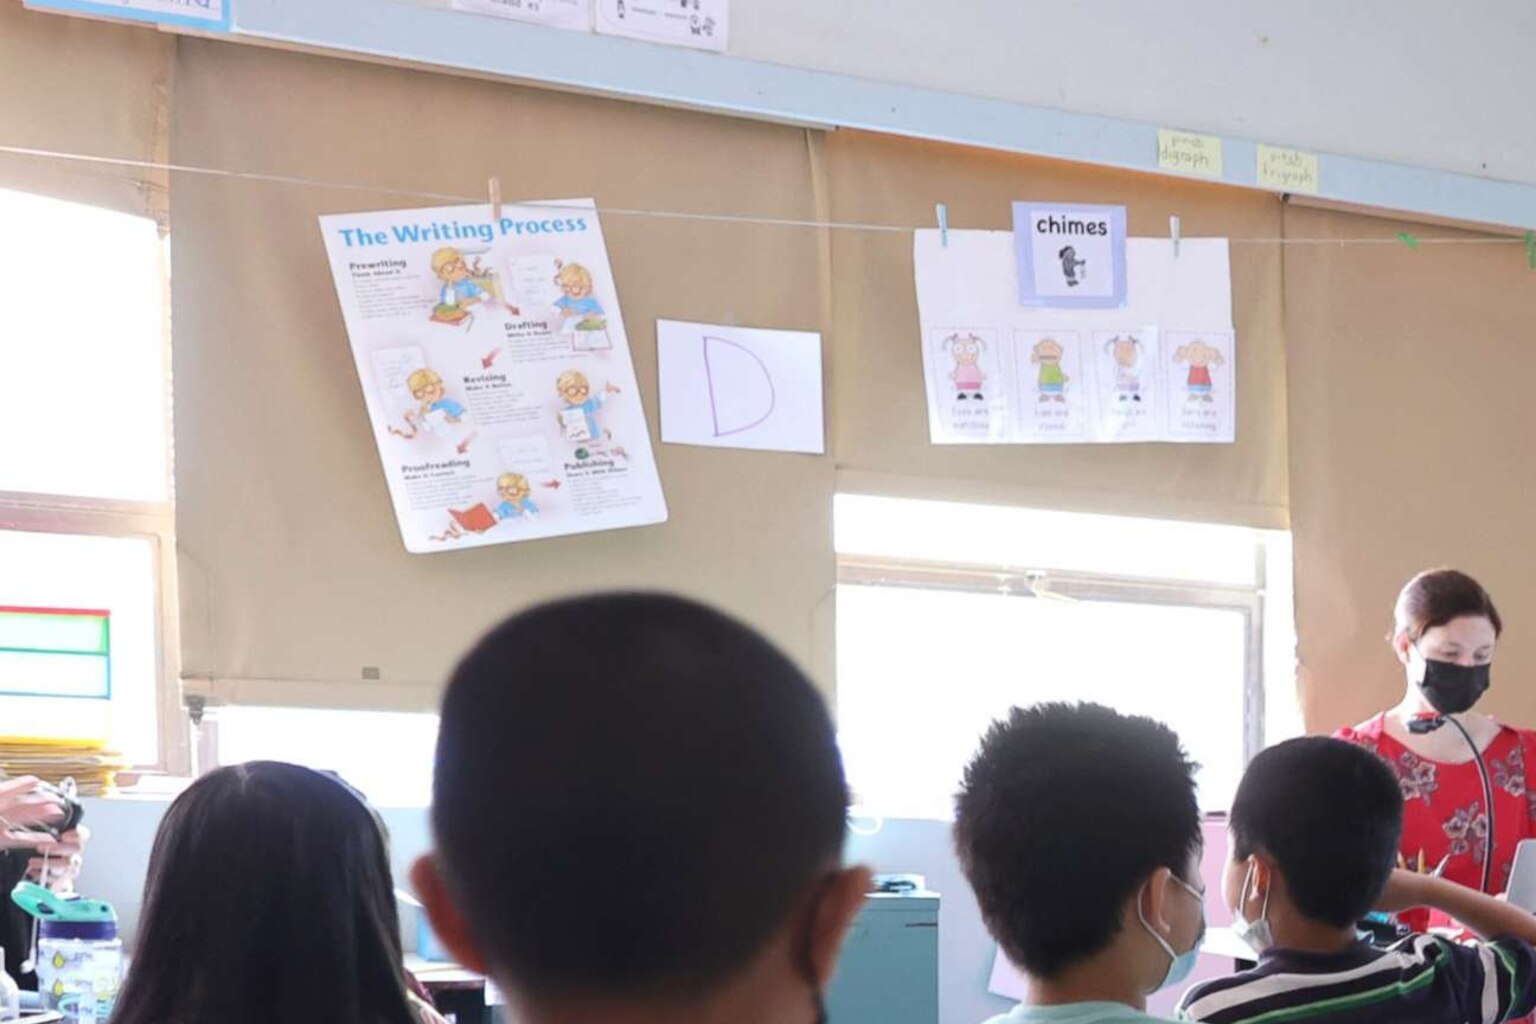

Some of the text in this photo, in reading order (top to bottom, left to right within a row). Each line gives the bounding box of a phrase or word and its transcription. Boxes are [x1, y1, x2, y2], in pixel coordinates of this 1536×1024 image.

[1160, 146, 1210, 168] digraph
[338, 216, 588, 247] The Writing Process
[1036, 214, 1108, 236] chimes
[349, 258, 408, 273] Prewriting
[504, 319, 548, 331] Drafting
[463, 373, 507, 385] Revising
[702, 335, 775, 437] D
[401, 457, 471, 474] Proofreading
[564, 458, 616, 471] Publishing
